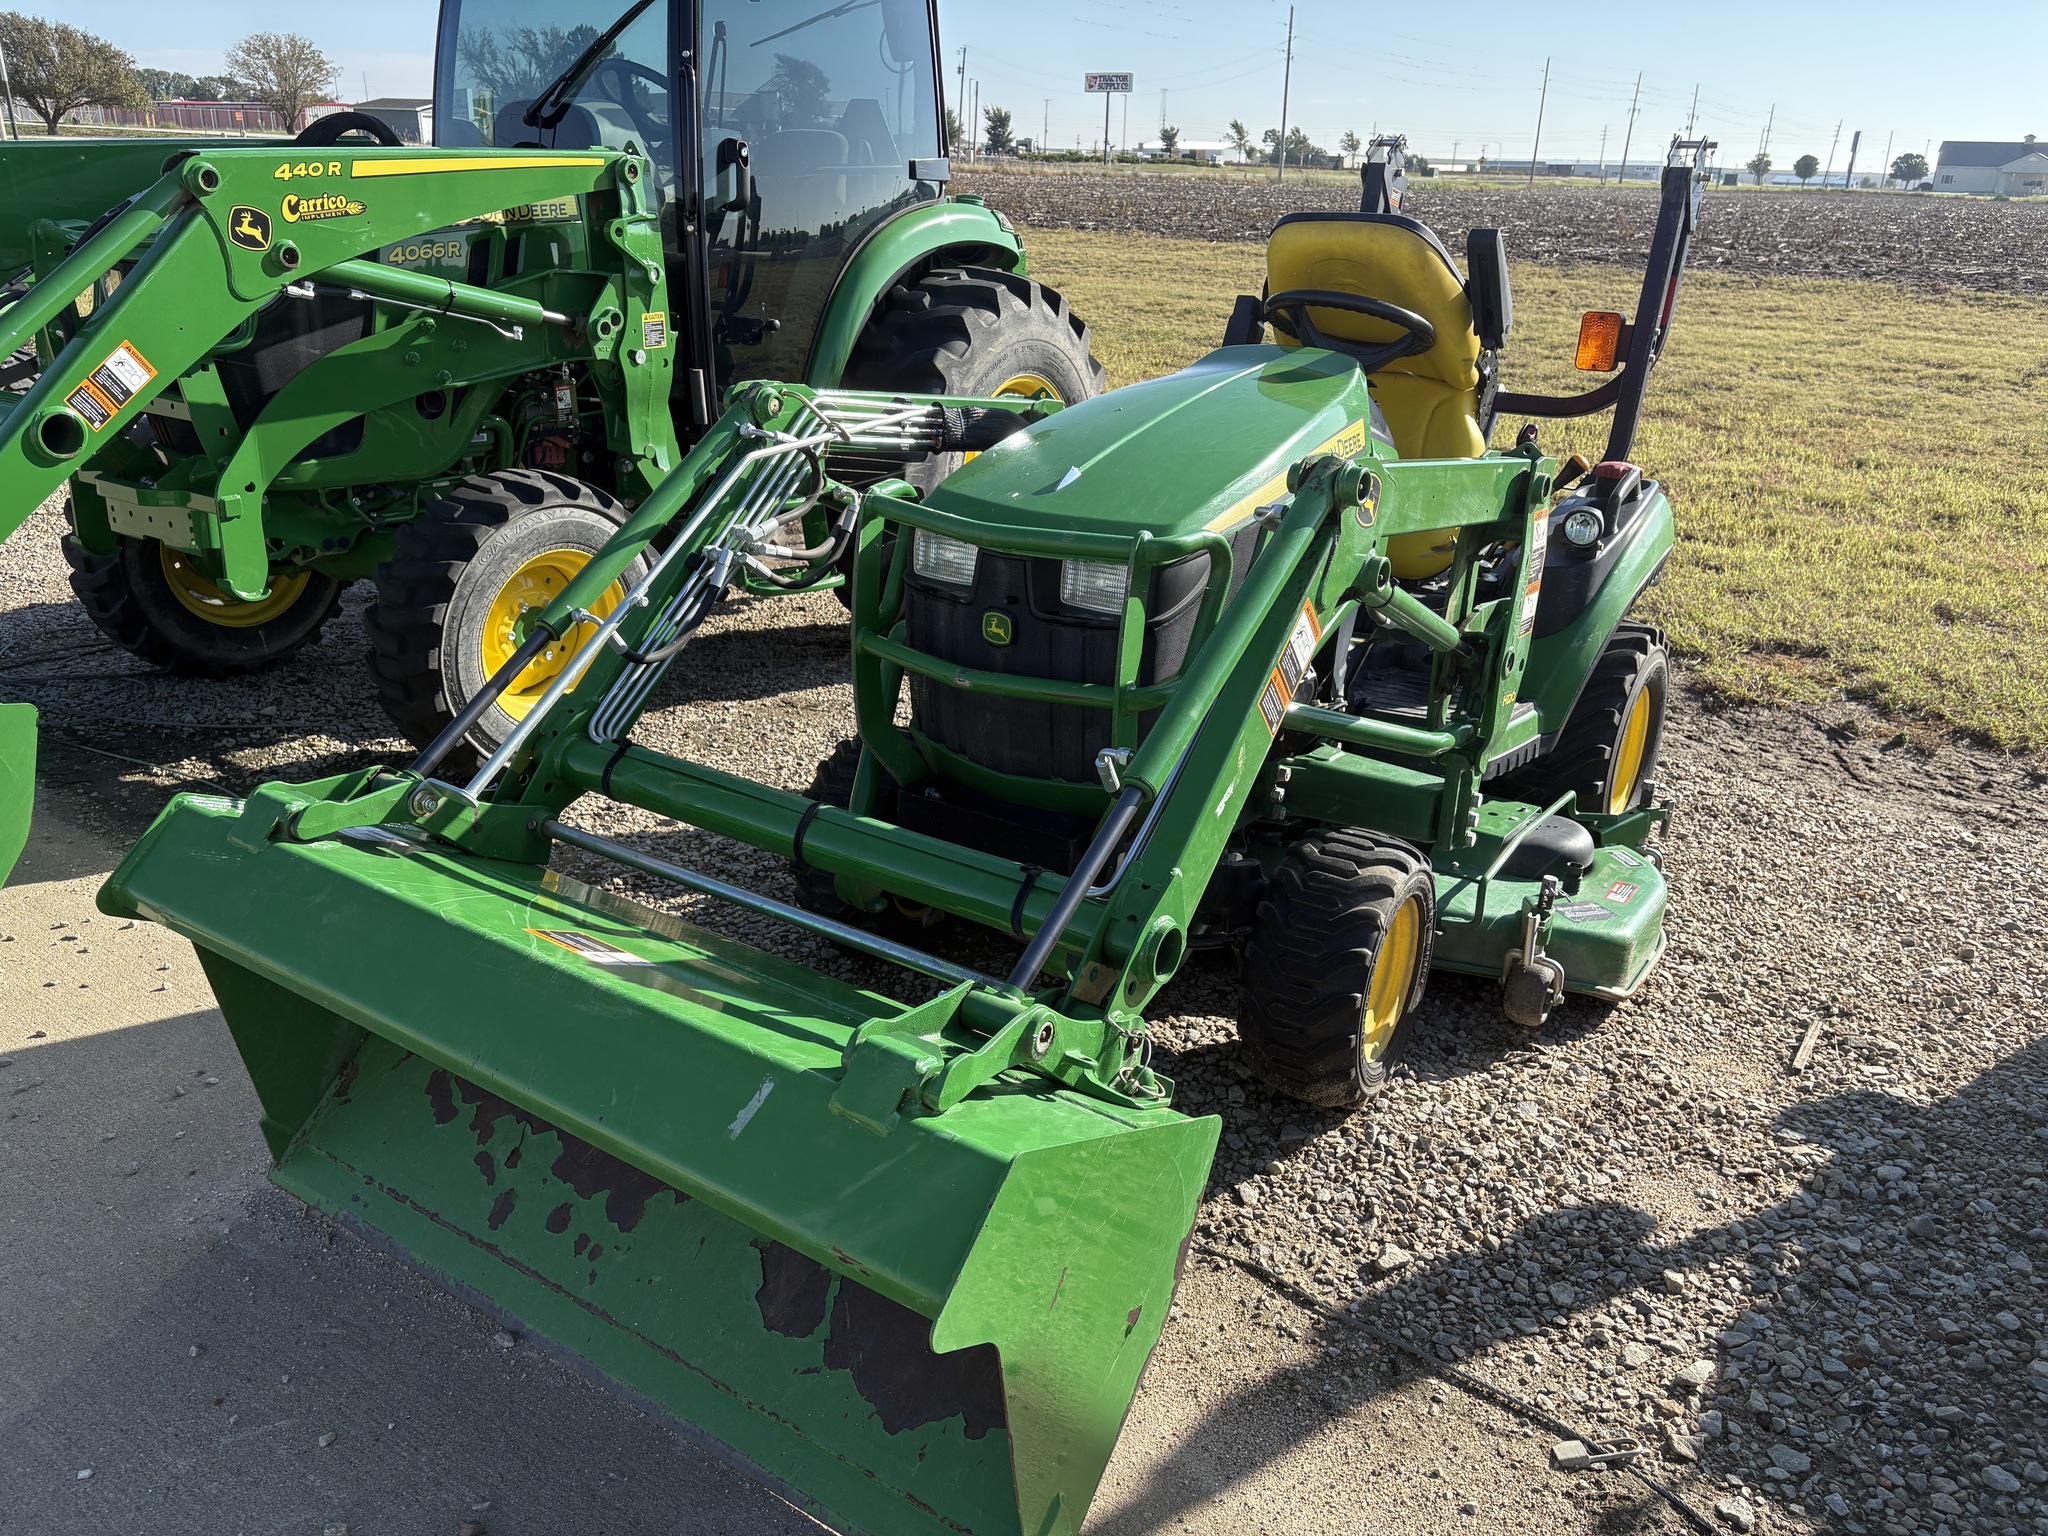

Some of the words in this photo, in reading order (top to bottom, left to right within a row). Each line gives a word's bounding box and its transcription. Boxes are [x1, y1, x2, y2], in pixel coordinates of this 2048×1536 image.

[274, 162, 324, 181] 440
[328, 161, 342, 176] R
[282, 192, 347, 223] Carrico
[301, 210, 346, 221] IMPLEMENT
[519, 203, 568, 219] DEERE
[388, 242, 445, 264] 4066
[447, 241, 461, 258] R
[131, 350, 153, 373] WARNING
[91, 389, 113, 412] WARNING
[1337, 432, 1362, 458] DEERE
